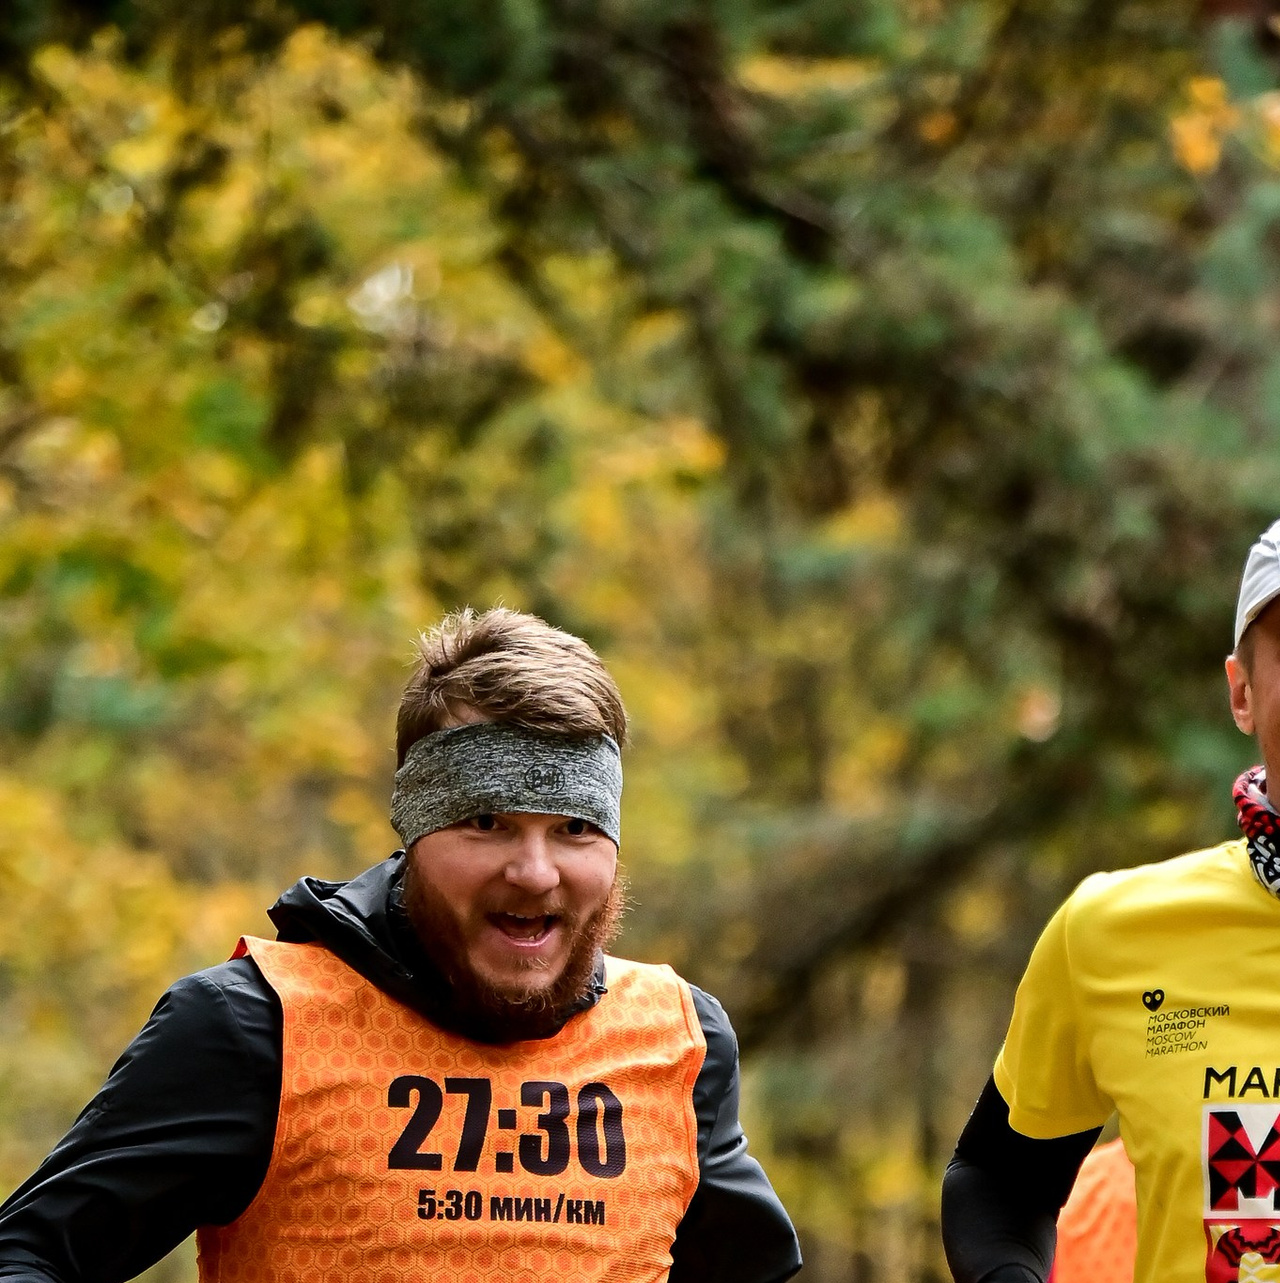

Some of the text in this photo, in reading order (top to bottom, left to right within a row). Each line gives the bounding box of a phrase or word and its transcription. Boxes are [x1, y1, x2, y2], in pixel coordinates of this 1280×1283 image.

[1148, 1004, 1230, 1024] МОСКОВСКИЙ
[1147, 1020, 1206, 1036] МАРАФОН
[1146, 1031, 1197, 1047] MOSCOW
[1145, 1041, 1208, 1059] MARATHON
[388, 1075, 626, 1178] 27:30
[417, 1189, 482, 1220] 5:30
